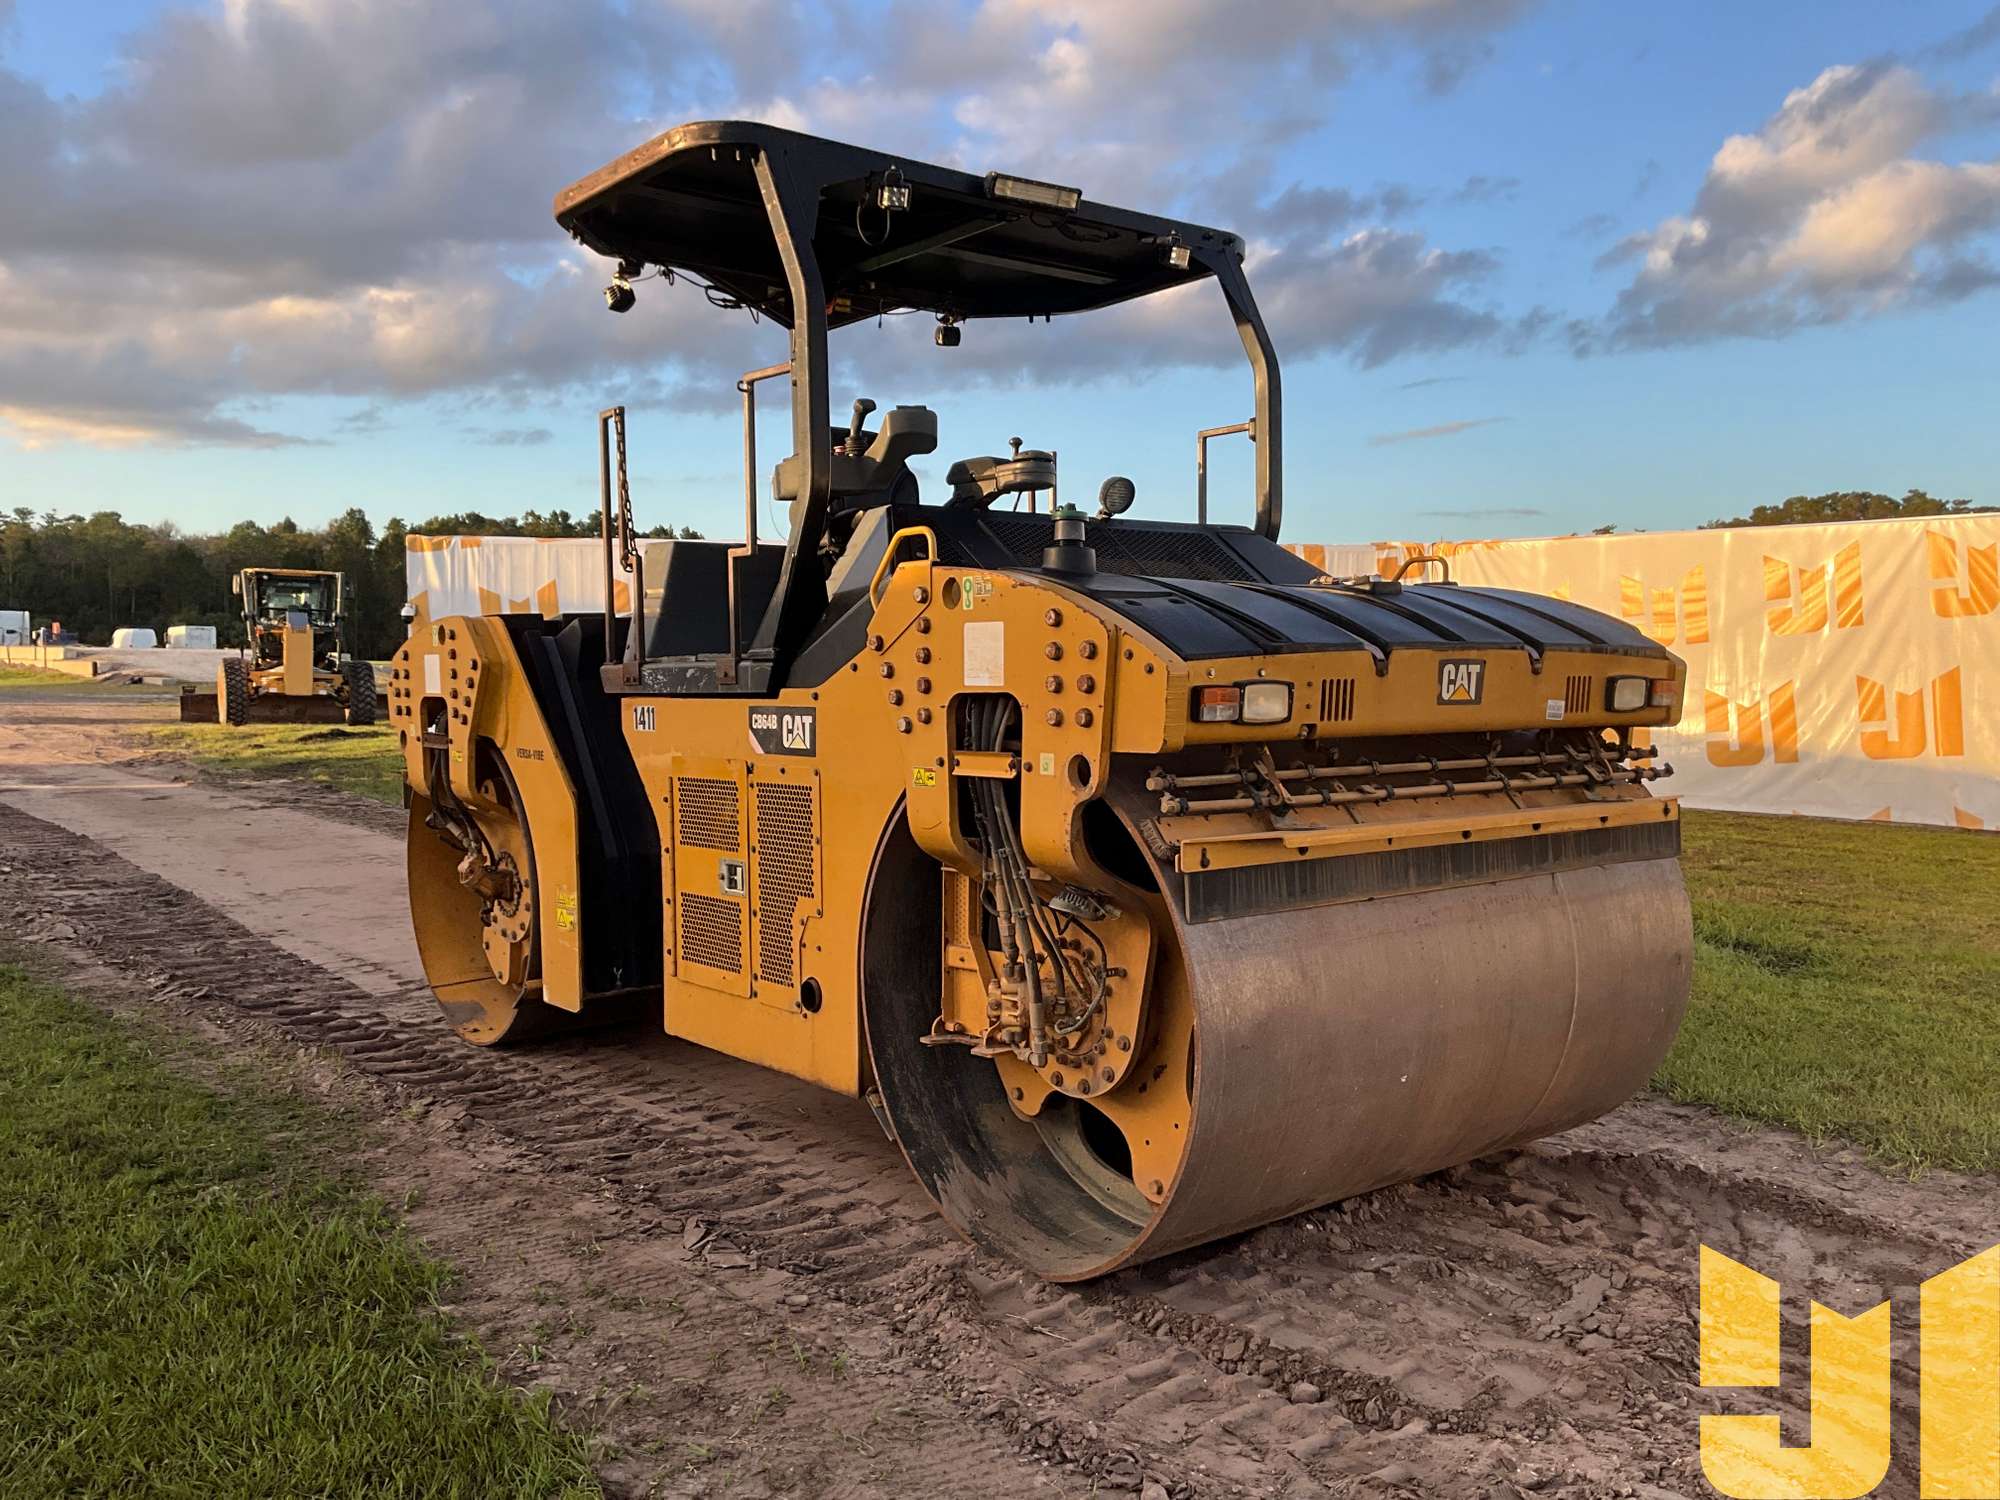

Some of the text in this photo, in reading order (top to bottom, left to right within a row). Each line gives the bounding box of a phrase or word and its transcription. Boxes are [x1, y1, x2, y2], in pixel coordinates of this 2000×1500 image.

[1441, 663, 1481, 701] CAT
[634, 706, 656, 731] 1411
[751, 713, 813, 749] CB64B CAT
